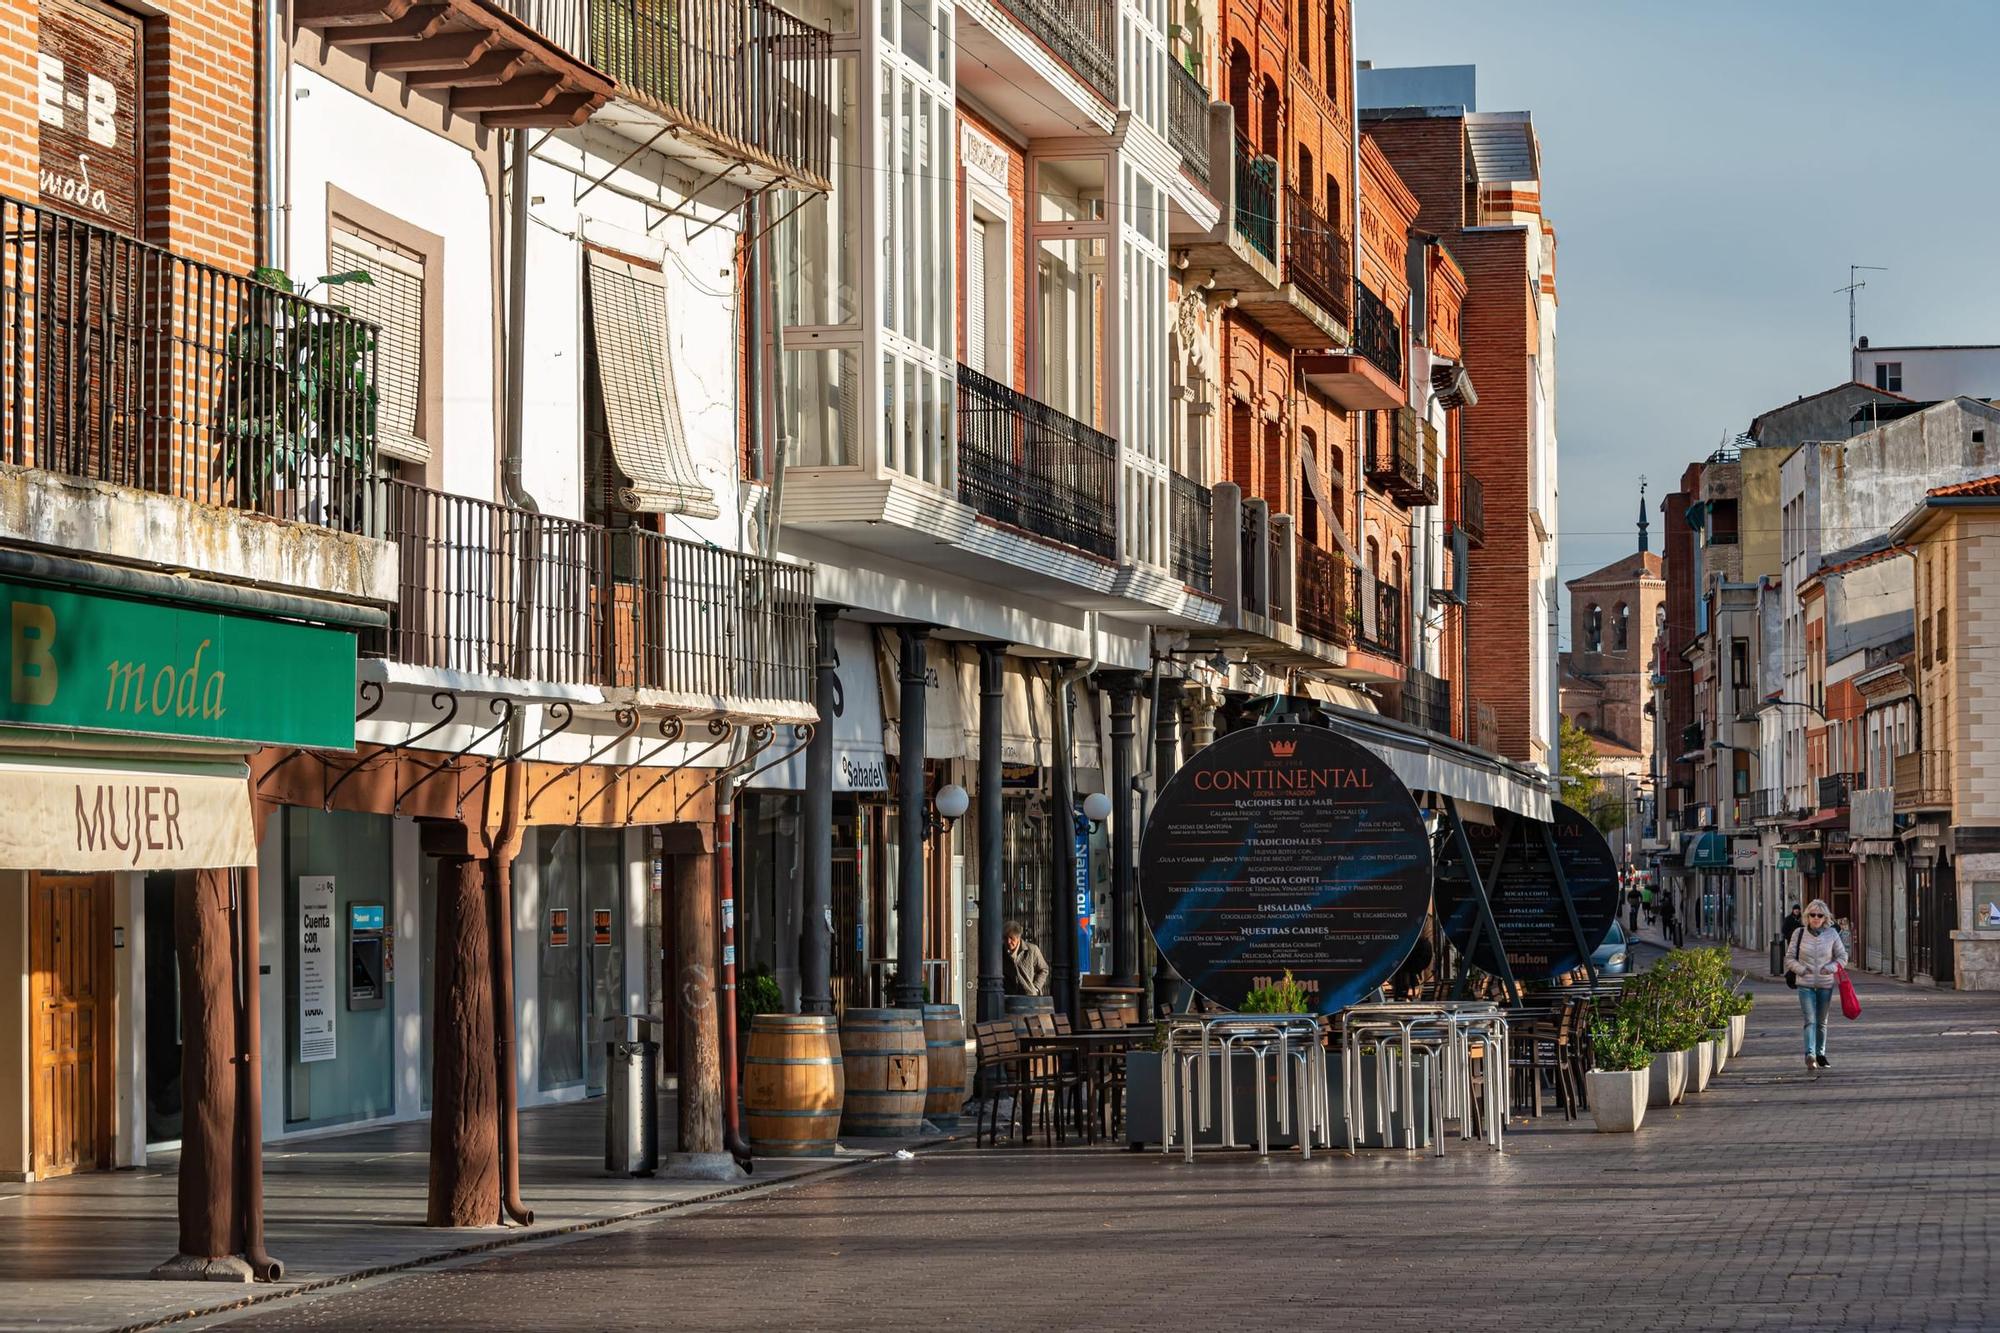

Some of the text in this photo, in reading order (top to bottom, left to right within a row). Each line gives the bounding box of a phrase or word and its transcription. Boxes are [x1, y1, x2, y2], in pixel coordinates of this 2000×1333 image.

[40, 153, 110, 215] moda
[11, 601, 226, 720] B moda
[1195, 769, 1373, 790] CONTINENTAL
[1235, 800, 1282, 808] RACIONES
[75, 784, 184, 867] MUJER
[1246, 838, 1322, 846] TRADICIONALES
[1258, 904, 1312, 912] ENSALADAS
[304, 914, 330, 929] Cuenta
[304, 932, 318, 944] con
[1240, 926, 1290, 936] NUESTRAS
[1252, 976, 1319, 993] Maou
